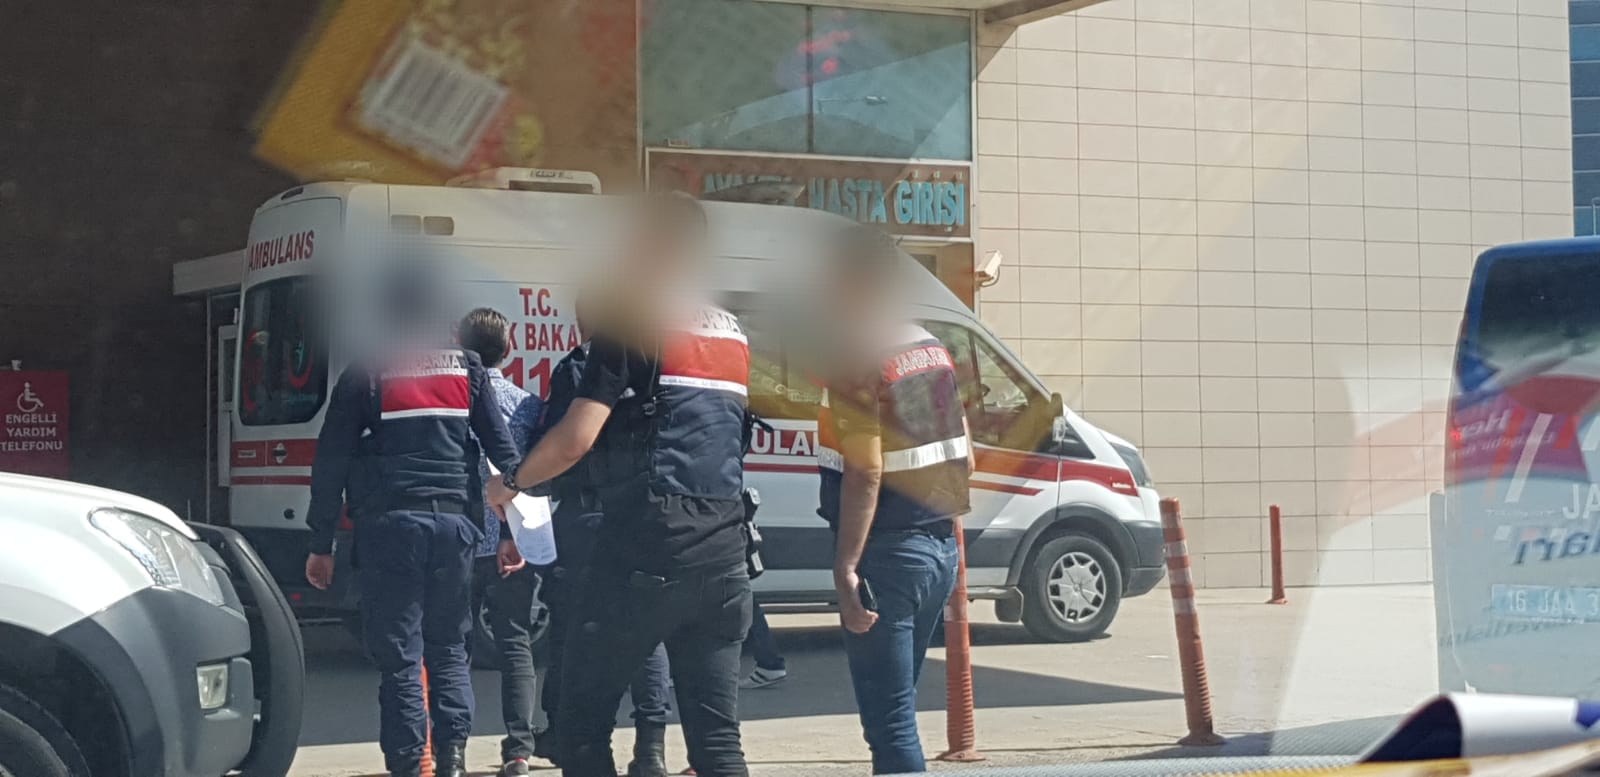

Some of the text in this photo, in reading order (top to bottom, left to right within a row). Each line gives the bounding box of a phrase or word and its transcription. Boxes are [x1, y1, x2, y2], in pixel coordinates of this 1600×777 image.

[808, 176, 888, 224] HASTA
[249, 230, 314, 271] AMBULANS
[519, 288, 558, 317] T.C.
[0, 440, 63, 451] TELEFONU
[6, 427, 57, 437] YARDIM
[1562, 483, 1600, 519] JA
